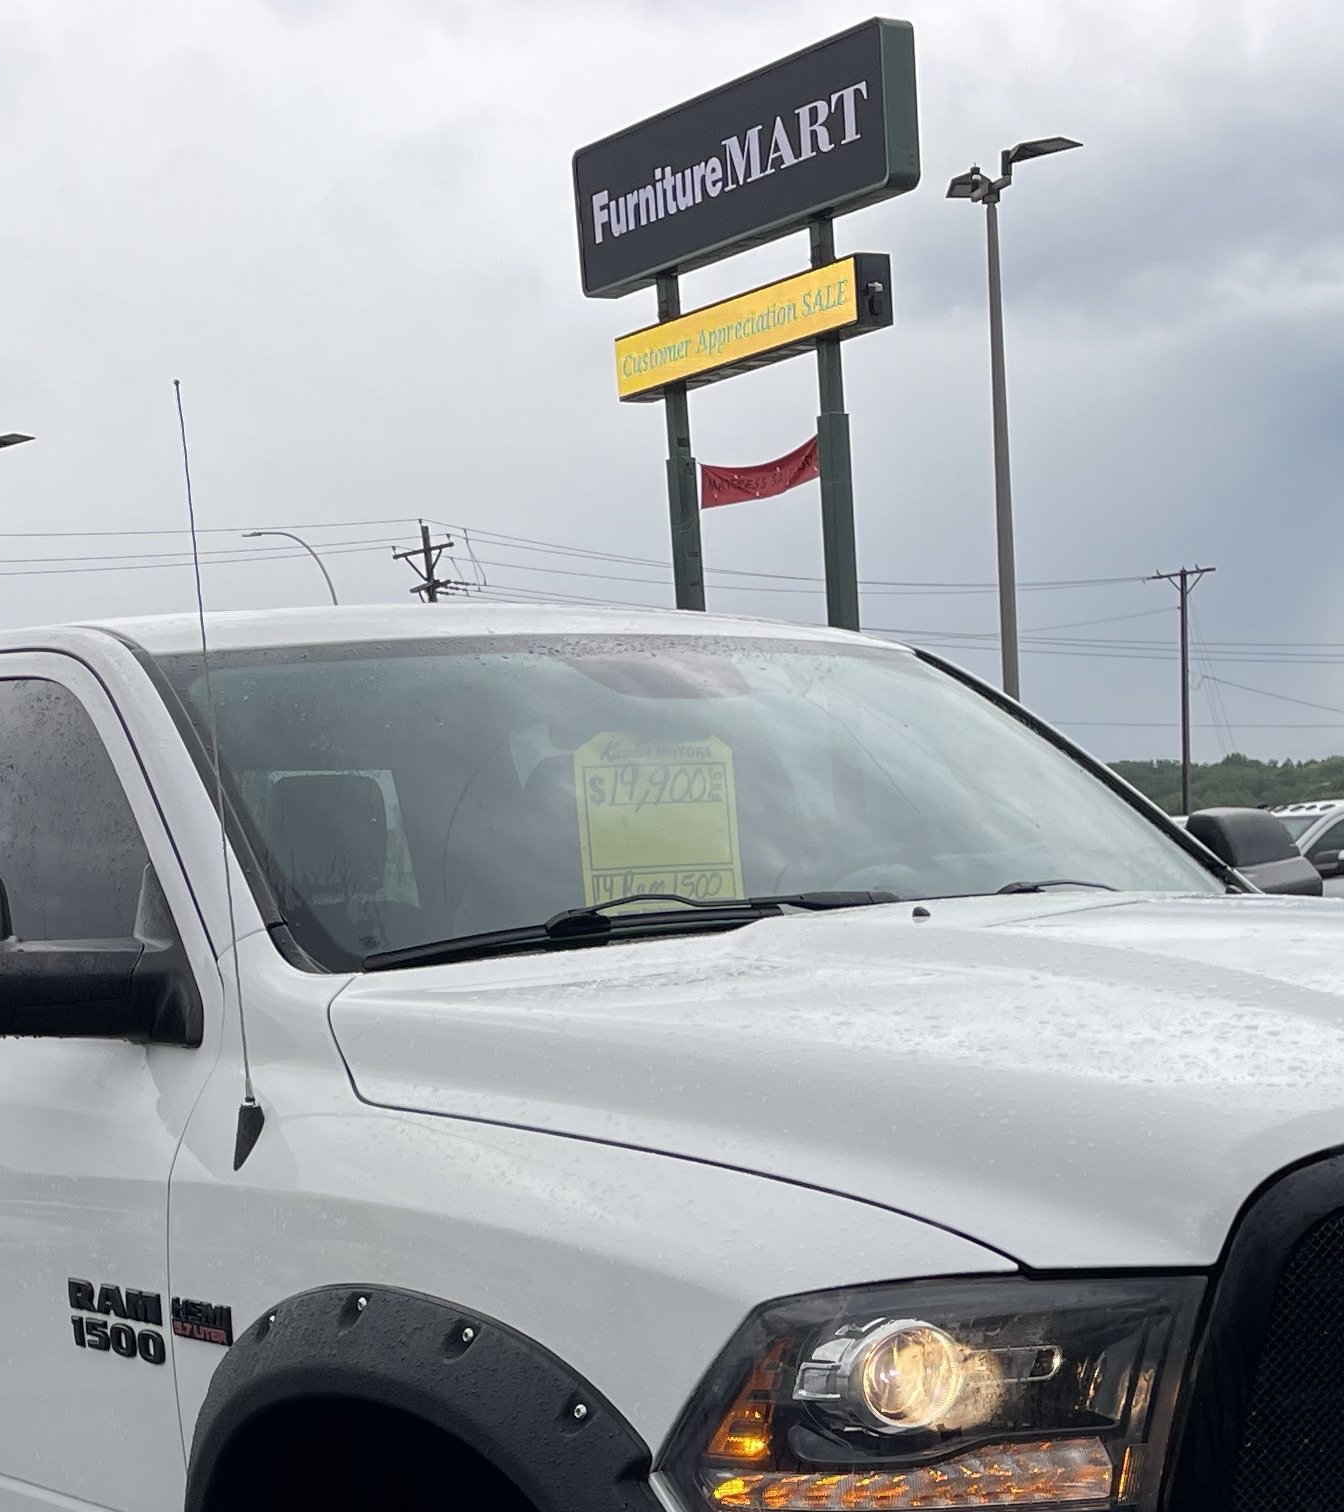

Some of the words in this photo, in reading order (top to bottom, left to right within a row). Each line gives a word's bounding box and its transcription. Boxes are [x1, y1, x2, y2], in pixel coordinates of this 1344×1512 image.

[592, 80, 869, 244] FurnitureMART
[622, 336, 691, 378] Customer
[696, 302, 798, 356] Appreciation
[801, 279, 849, 317] SALE
[674, 871, 723, 899] 1500
[68, 1277, 163, 1327] RAM
[71, 1315, 166, 1365] 1500
